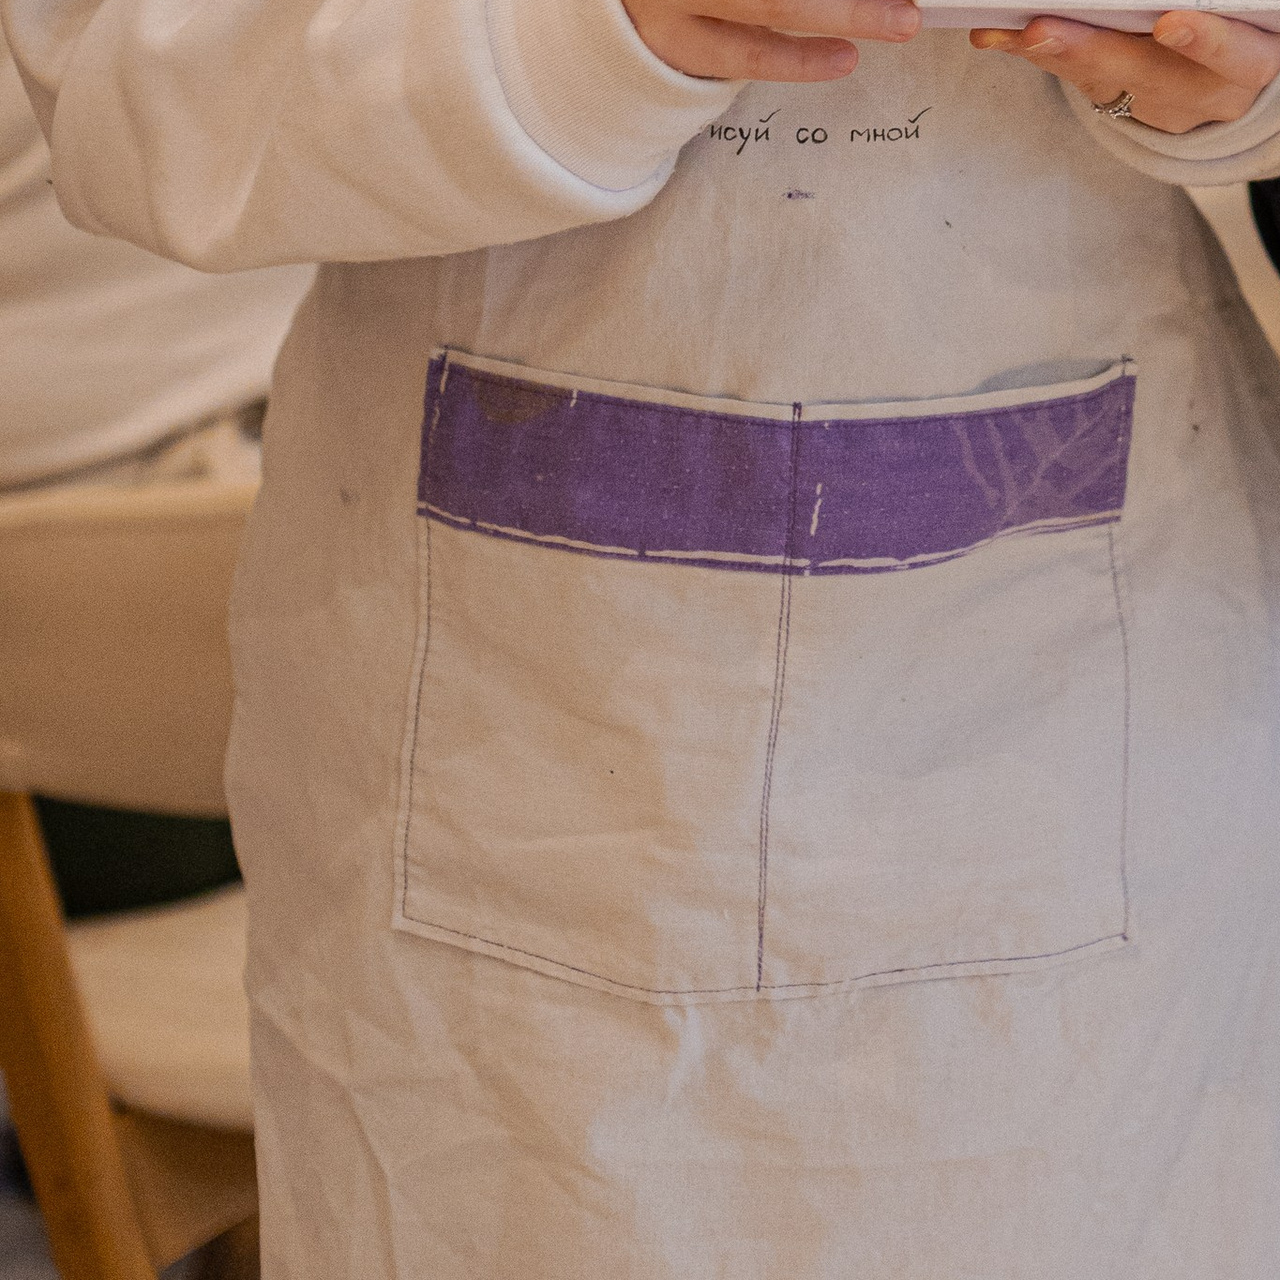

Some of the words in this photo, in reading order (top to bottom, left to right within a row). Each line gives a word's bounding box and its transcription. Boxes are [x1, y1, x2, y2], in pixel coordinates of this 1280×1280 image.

[698, 107, 782, 156] исуй
[796, 126, 828, 144] со
[850, 106, 932, 143] мной
